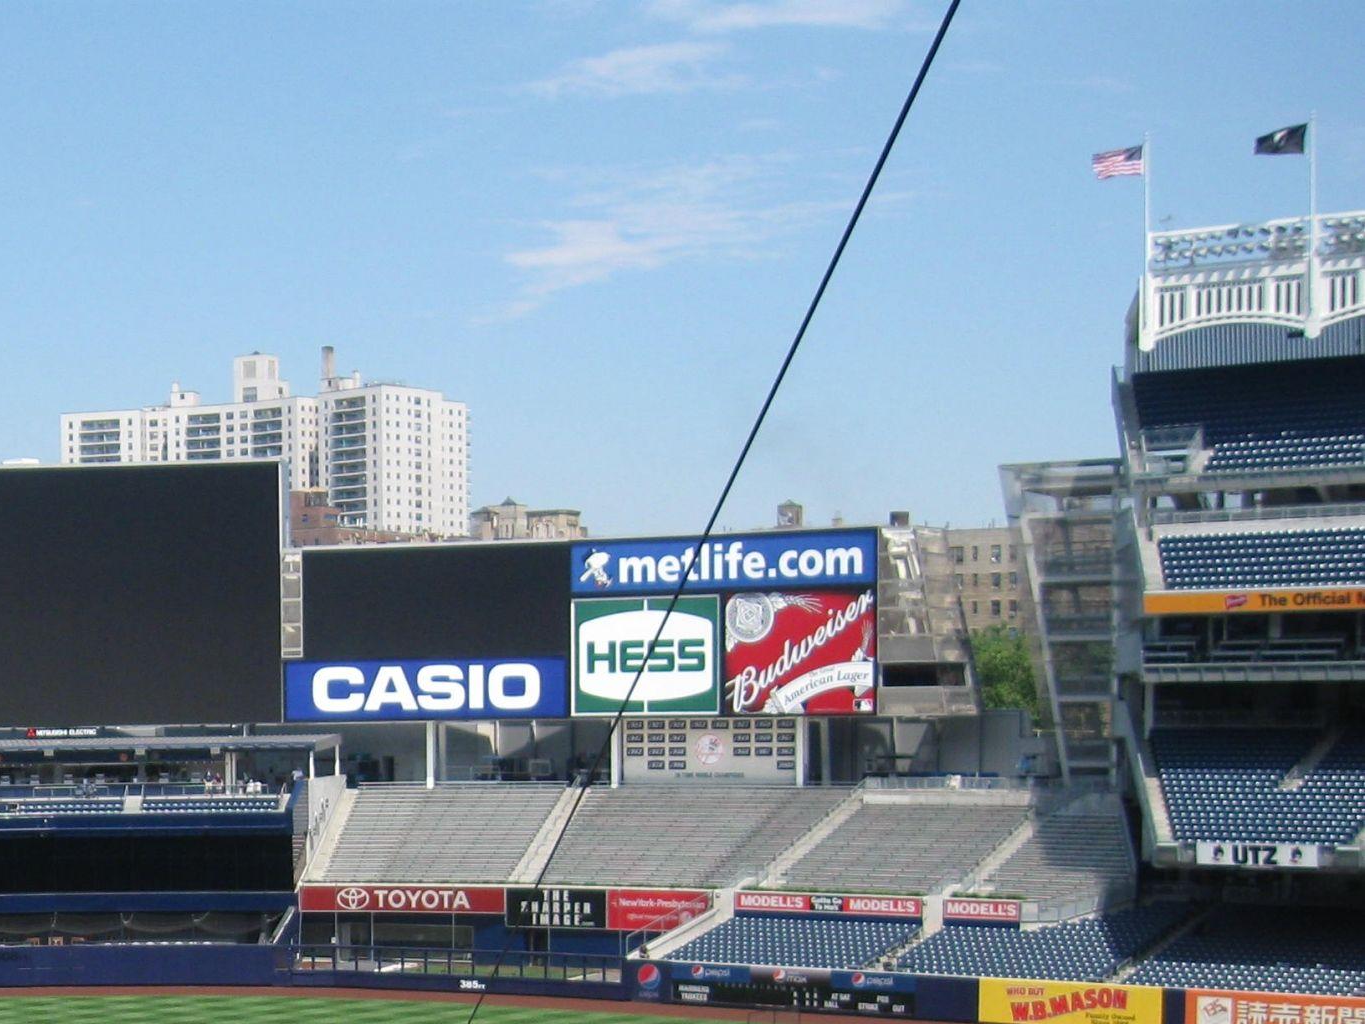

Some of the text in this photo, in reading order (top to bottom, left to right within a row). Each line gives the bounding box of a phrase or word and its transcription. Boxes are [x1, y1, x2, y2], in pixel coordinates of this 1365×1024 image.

[618, 541, 864, 585] metlife.com
[1260, 593, 1288, 606] The
[1292, 591, 1352, 606] Official
[586, 639, 706, 673] HESS
[724, 588, 874, 713] Budweiser
[311, 663, 541, 712] CASIO
[783, 674, 834, 704] American
[836, 669, 870, 684] Lager
[1234, 846, 1277, 864] UTZ
[374, 890, 471, 909] TOYOTA
[543, 890, 569, 901] THE
[740, 894, 804, 908] MODELL'S
[849, 898, 915, 912] MODELL'S
[947, 902, 1016, 917] MODELL'S
[533, 913, 582, 926] IMAGE
[704, 968, 730, 977] pepsi
[867, 977, 893, 985] pepsi
[1007, 987, 1044, 995] WHO BUT
